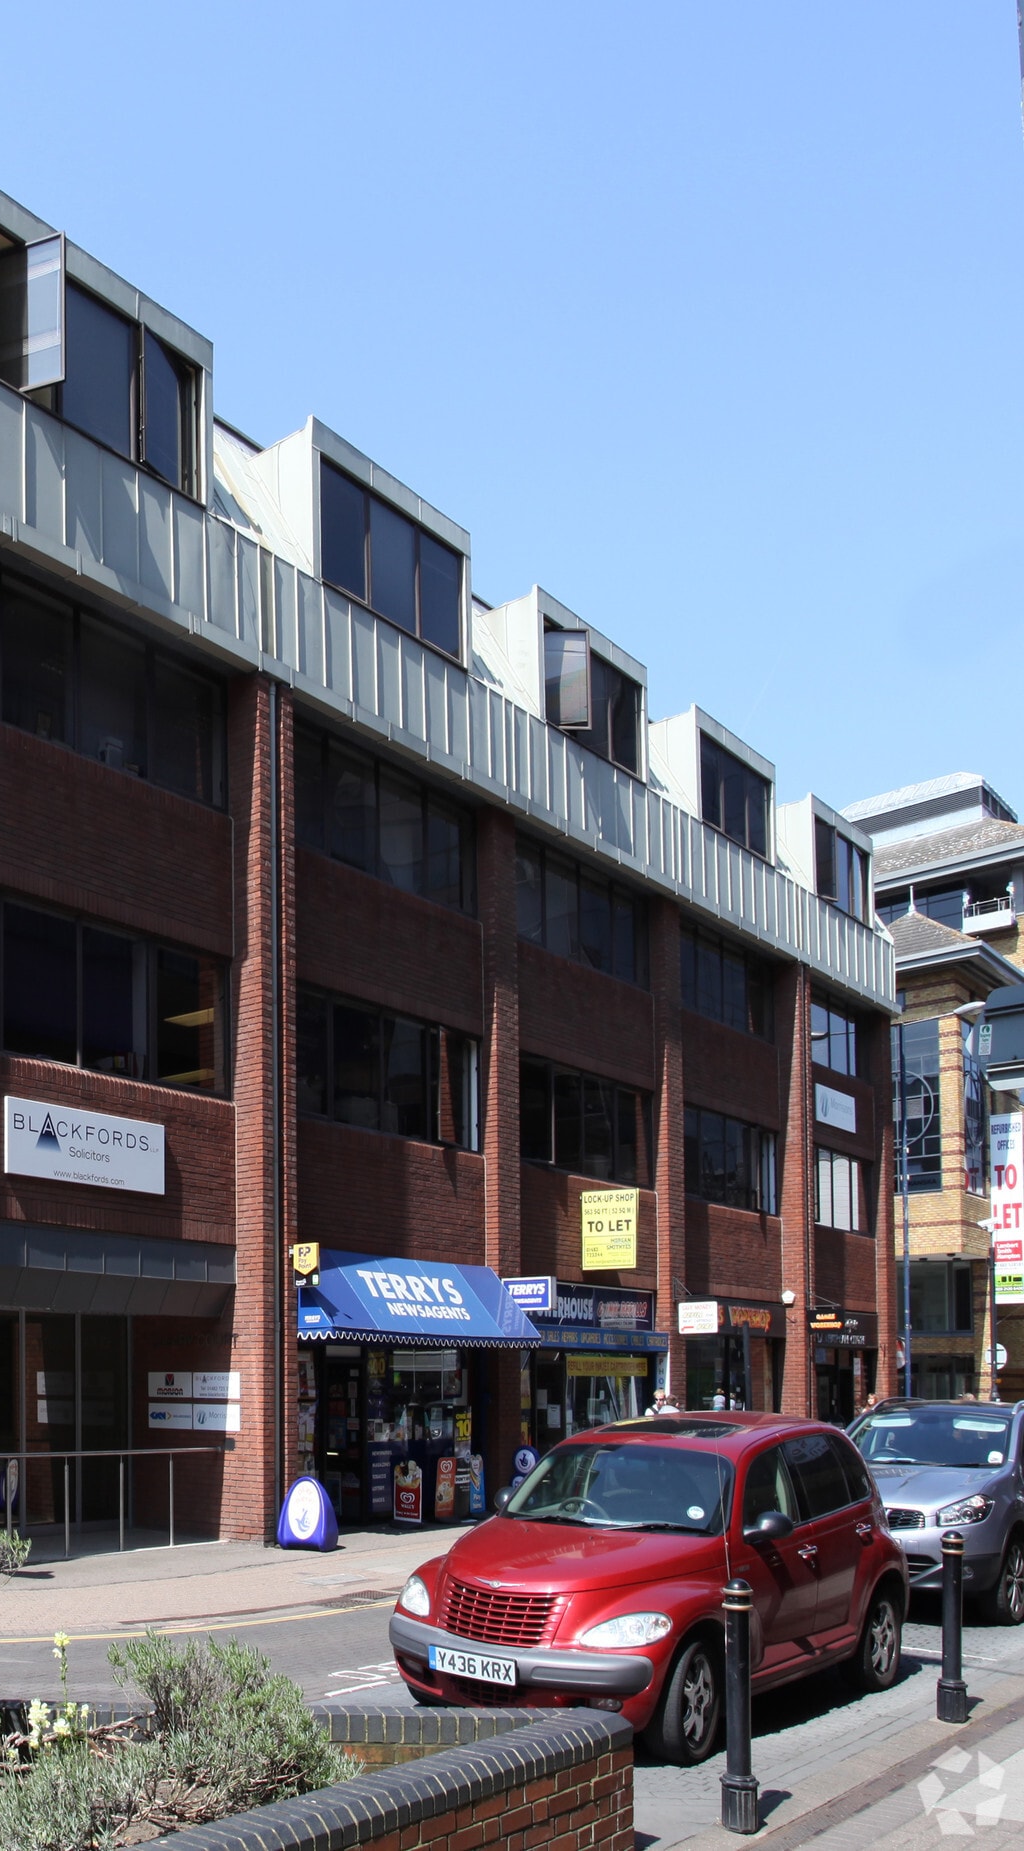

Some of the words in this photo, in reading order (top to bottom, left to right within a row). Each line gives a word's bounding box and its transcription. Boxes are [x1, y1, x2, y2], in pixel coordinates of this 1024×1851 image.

[13, 1111, 149, 1151] BLACKFORDS
[69, 1146, 110, 1163] Solicitors
[997, 1140, 1015, 1151] OFFICES
[53, 1169, 125, 1186] www.blackfords.com
[994, 1163, 1017, 1190] TO
[584, 1194, 614, 1204] LOCK-UP
[615, 1193, 635, 1203] SHOP
[993, 1202, 1022, 1230] LET
[587, 1220, 604, 1232] TO
[609, 1219, 632, 1232] LET
[356, 1270, 463, 1305] TERRYS
[508, 1283, 546, 1296] TERRYS
[386, 1302, 471, 1321] NEWSAGENTS
[728, 1305, 773, 1332] WORKSHOP
[809, 1321, 843, 1329] WORKSHOP
[438, 1651, 477, 1675] Y436
[480, 1659, 512, 1682] KRX
